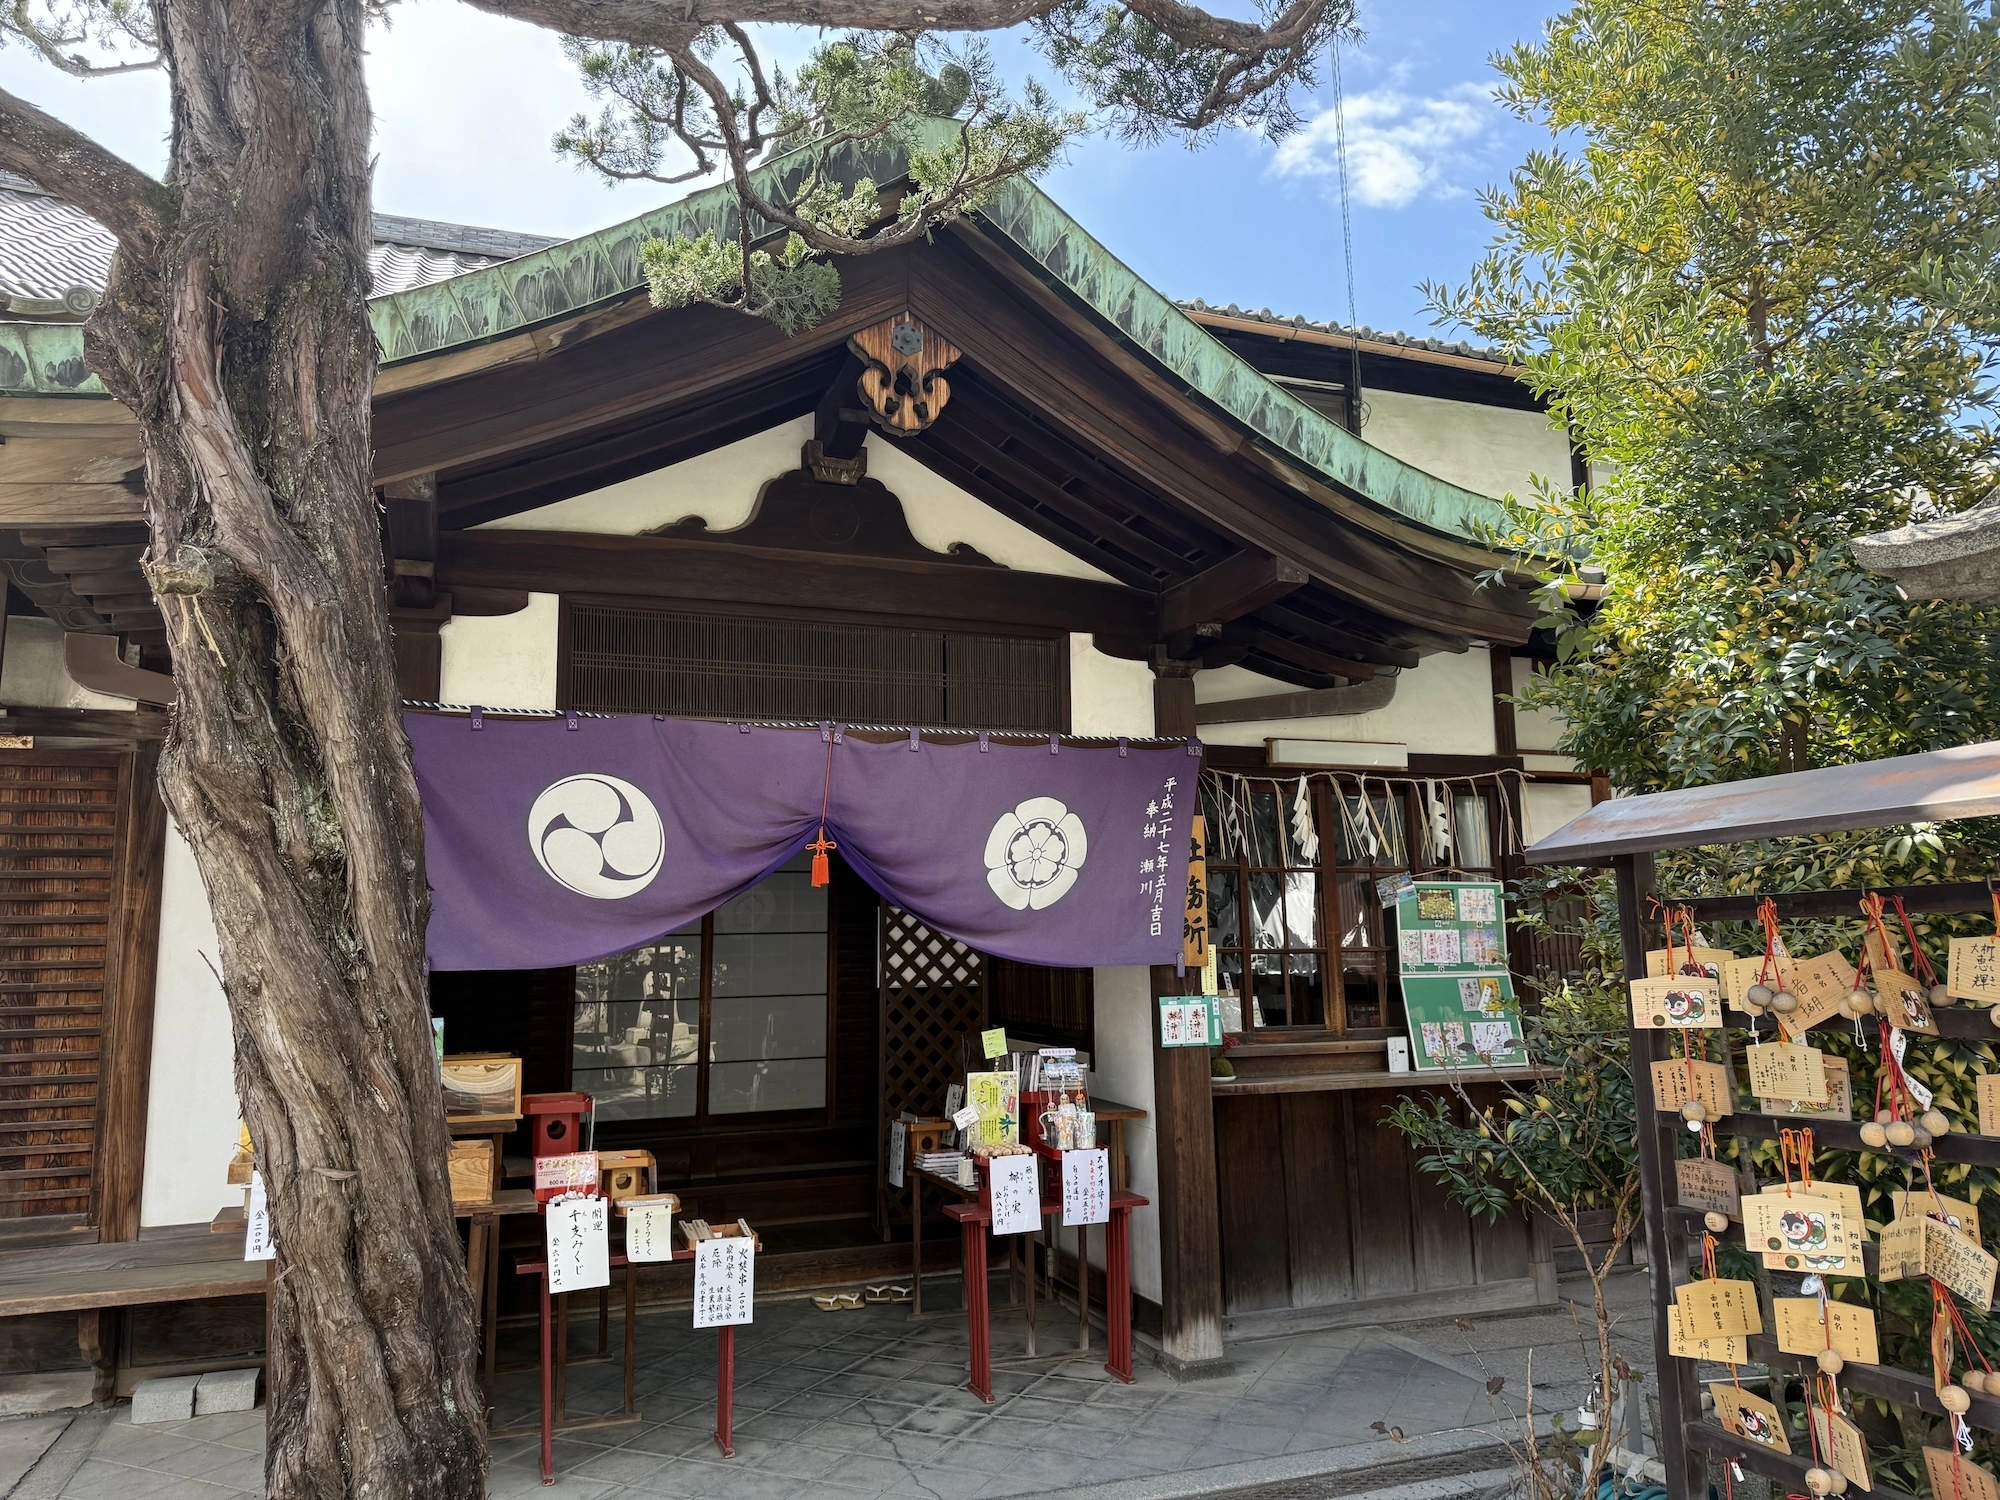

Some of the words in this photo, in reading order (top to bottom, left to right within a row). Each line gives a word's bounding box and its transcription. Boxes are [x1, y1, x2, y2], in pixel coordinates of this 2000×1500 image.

[1143, 799, 1159, 839] 奉納
[1150, 776, 1178, 937] 平成二十七年五月吉日
[1140, 859, 1155, 895] 瀬川
[591, 1207, 603, 1231] 開運
[1830, 1211, 1843, 1244] 初宮詣
[712, 1248, 722, 1268] 厄除
[725, 1244, 735, 1279] 家内安全
[1848, 1231, 1861, 1264] 初宮詣
[724, 1285, 732, 1320] 交通安全
[1833, 1313, 1842, 1331] 命名
